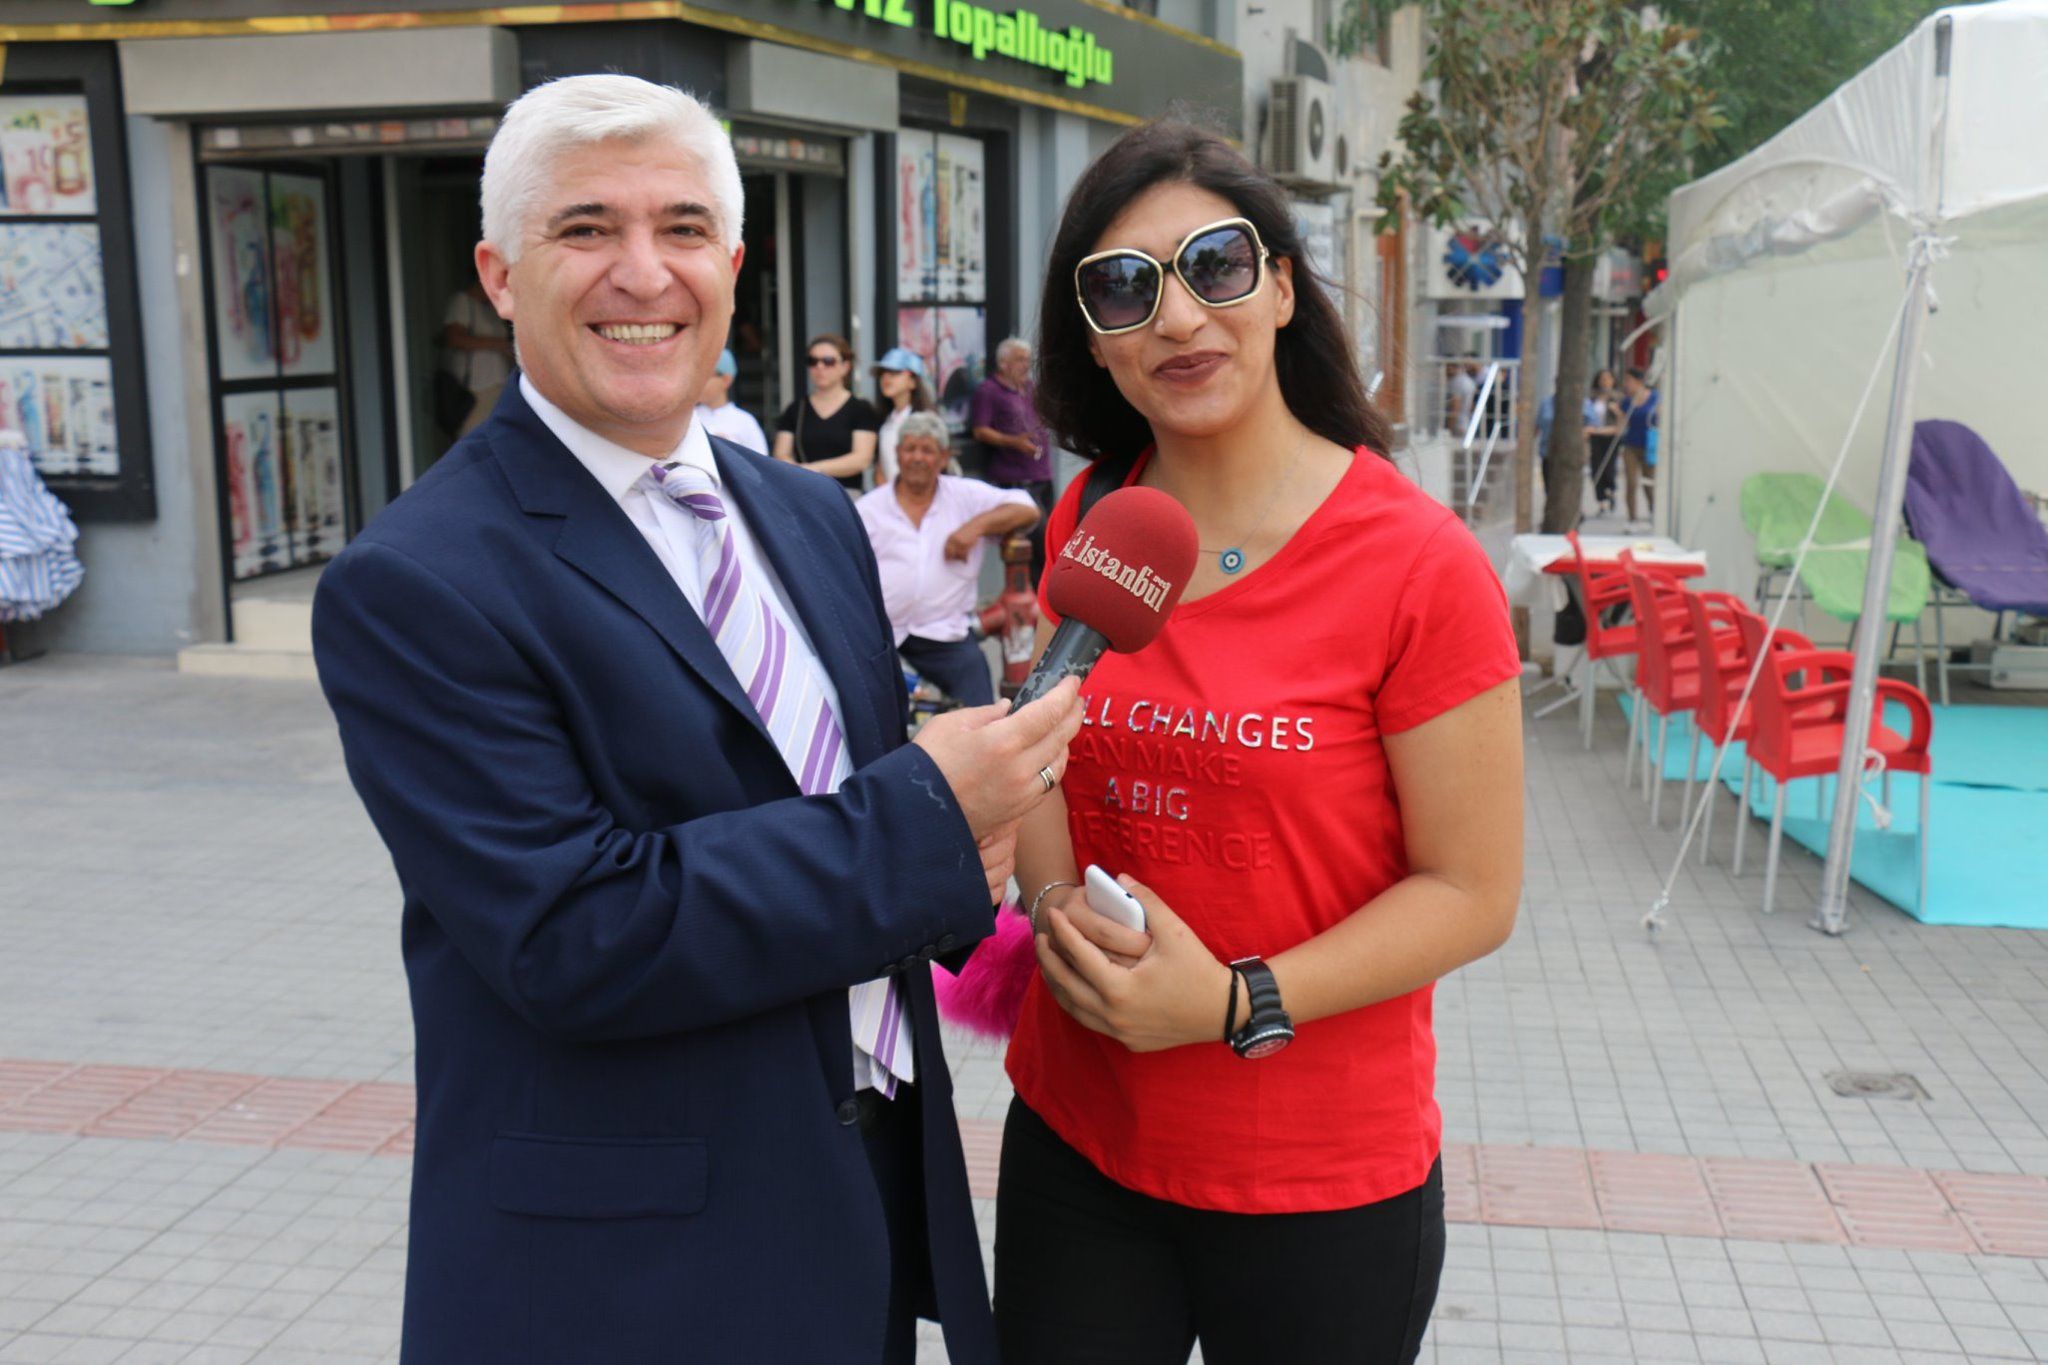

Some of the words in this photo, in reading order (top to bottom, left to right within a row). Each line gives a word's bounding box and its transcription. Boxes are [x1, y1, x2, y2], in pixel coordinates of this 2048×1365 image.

[1082, 695, 1114, 727] LL
[1128, 701, 1315, 751] CHANGES
[1068, 732, 1126, 770] AN
[1134, 739, 1241, 787] MAKE
[1105, 776, 1126, 810] A
[1131, 780, 1190, 820] BIG
[1071, 811, 1273, 871] IFFERENCE
